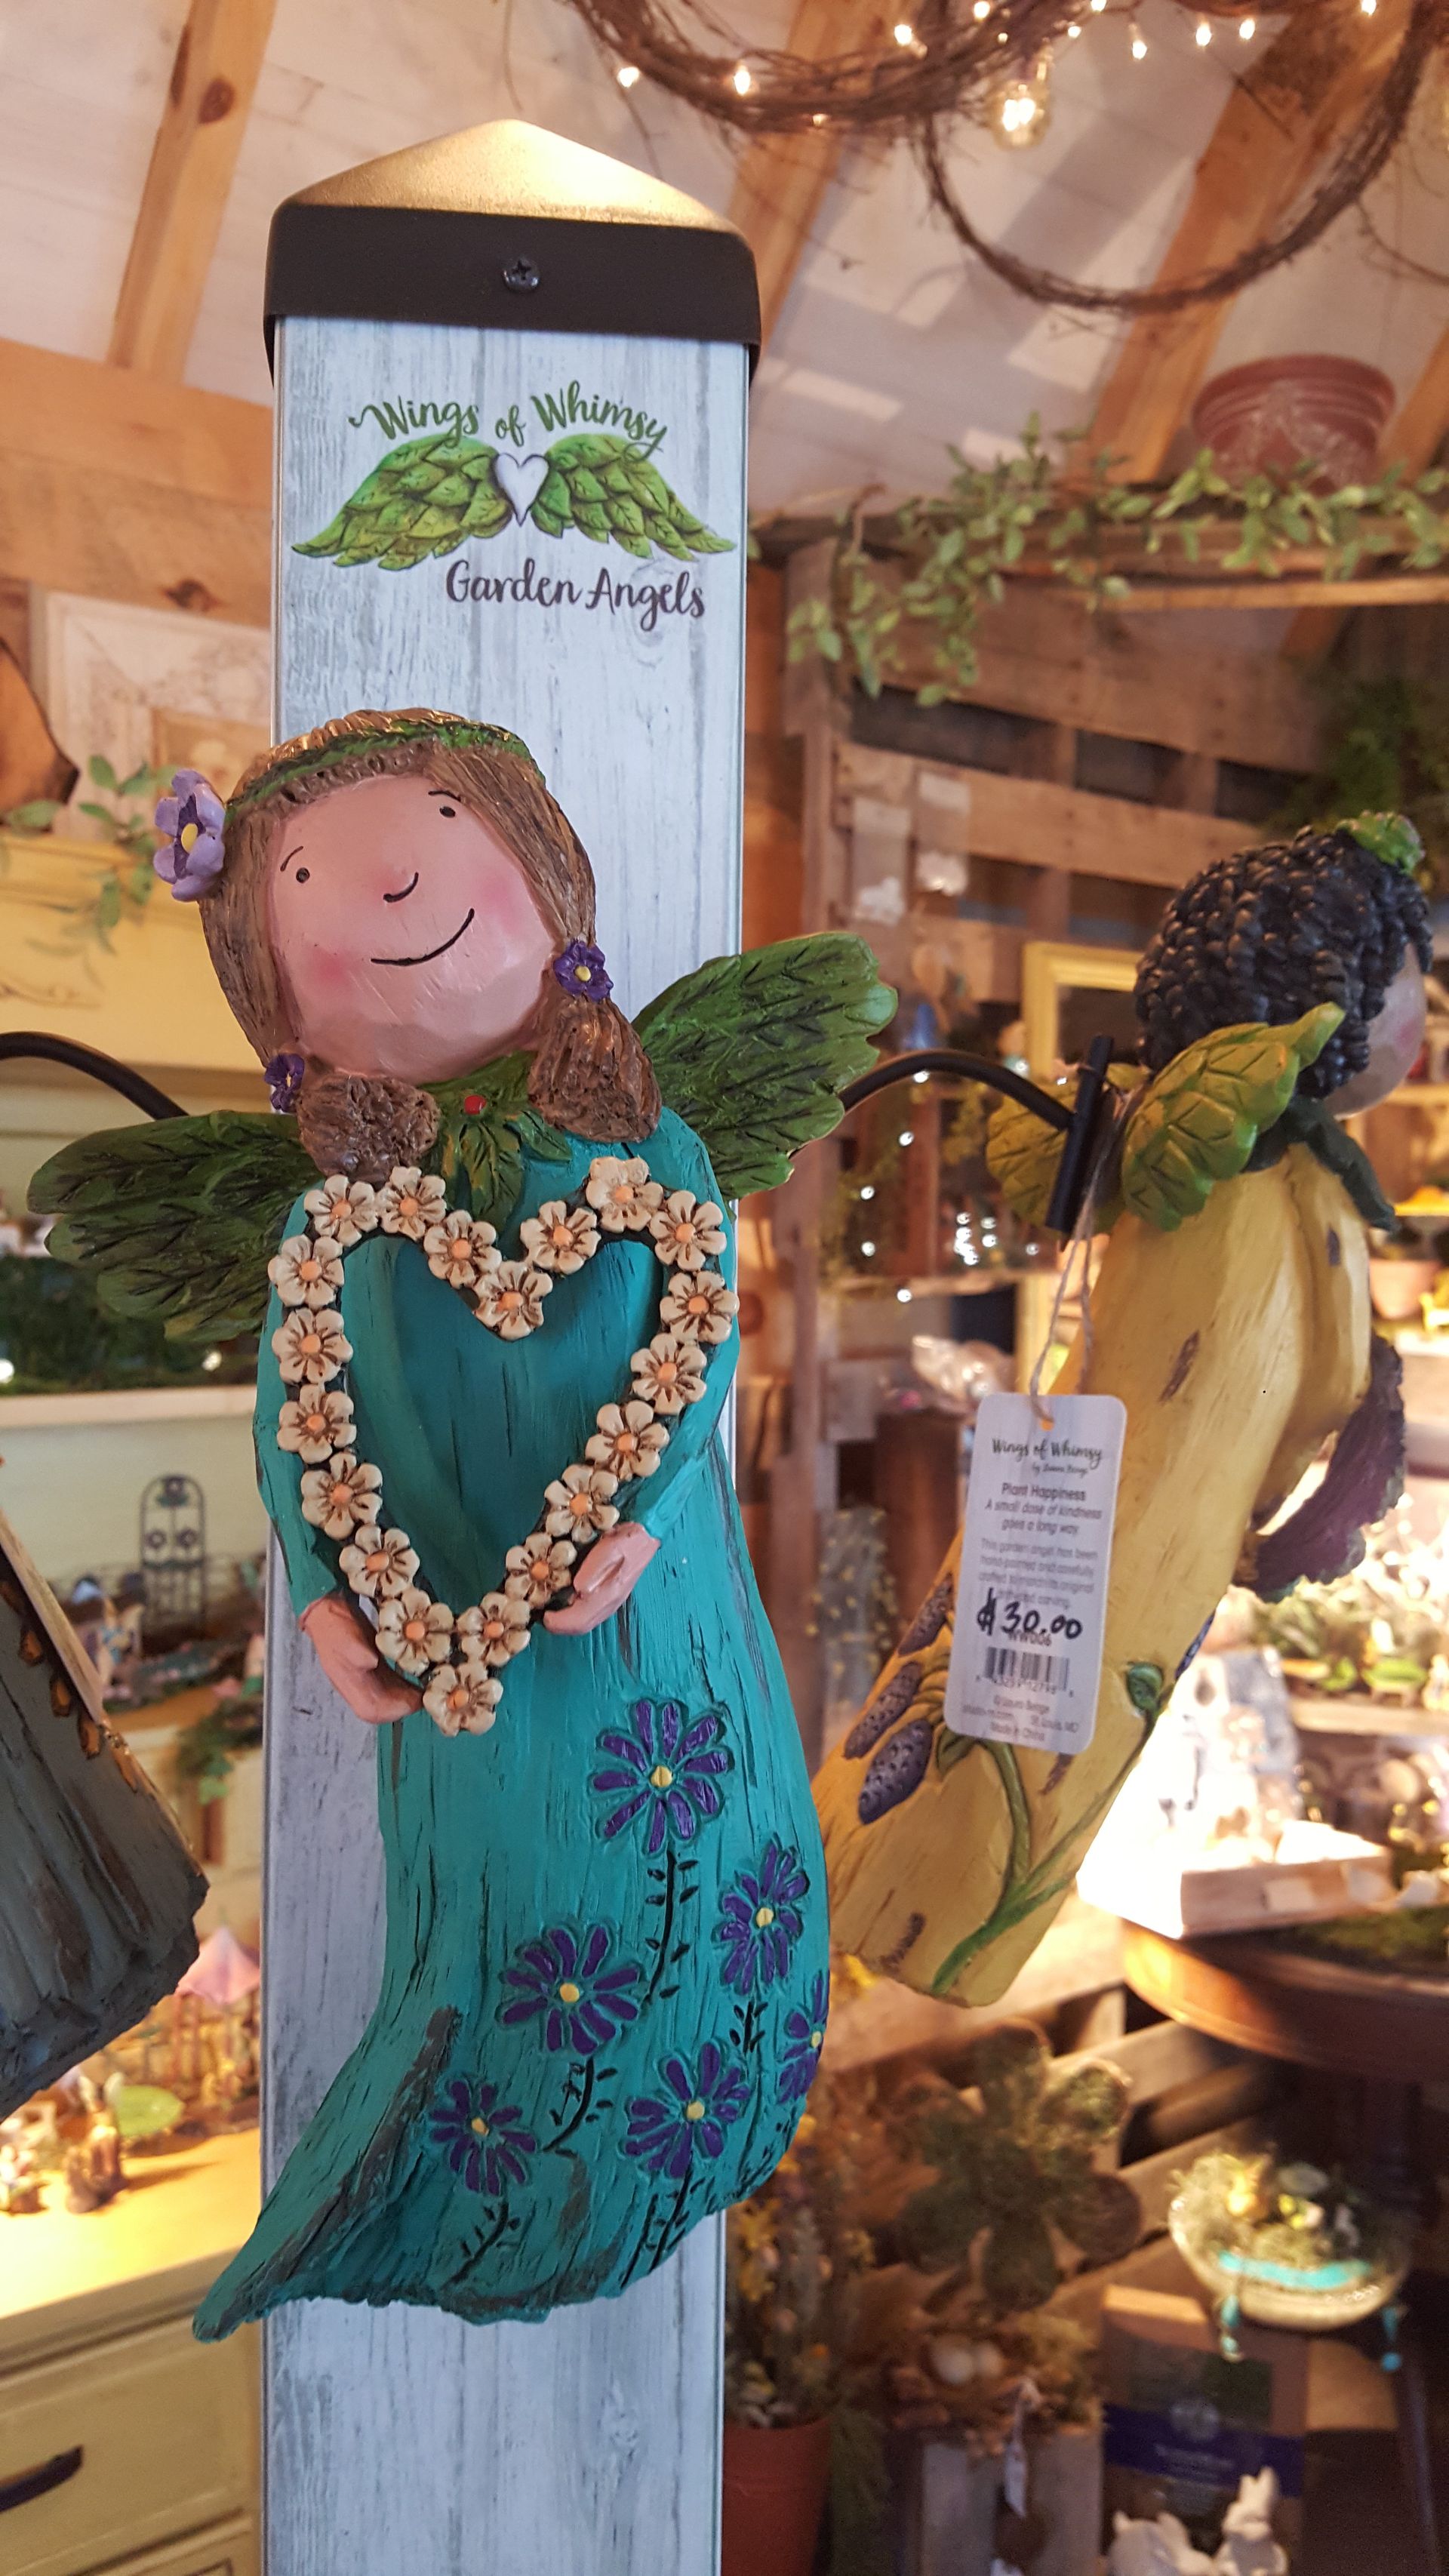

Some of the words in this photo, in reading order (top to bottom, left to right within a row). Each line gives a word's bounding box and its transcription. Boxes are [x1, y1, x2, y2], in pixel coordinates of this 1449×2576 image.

[348, 395, 479, 449] Wings
[495, 405, 525, 446] of
[531, 380, 668, 462] Whimsy
[446, 559, 583, 606] Garden
[586, 568, 705, 632] Angels
[992, 1438, 1029, 1463] Wings
[1033, 1438, 1048, 1460] of
[1051, 1439, 1102, 1470] Whimsy
[1001, 1482, 1028, 1495] Plant
[1031, 1485, 1086, 1501] Happiness
[985, 1499, 992, 1510] A
[995, 1501, 1020, 1512] small
[1022, 1503, 1044, 1515] dose
[1047, 1505, 1058, 1516] of
[1059, 1507, 1102, 1519] kindness
[1001, 1519, 1025, 1531] goes
[1036, 1521, 1057, 1535] long
